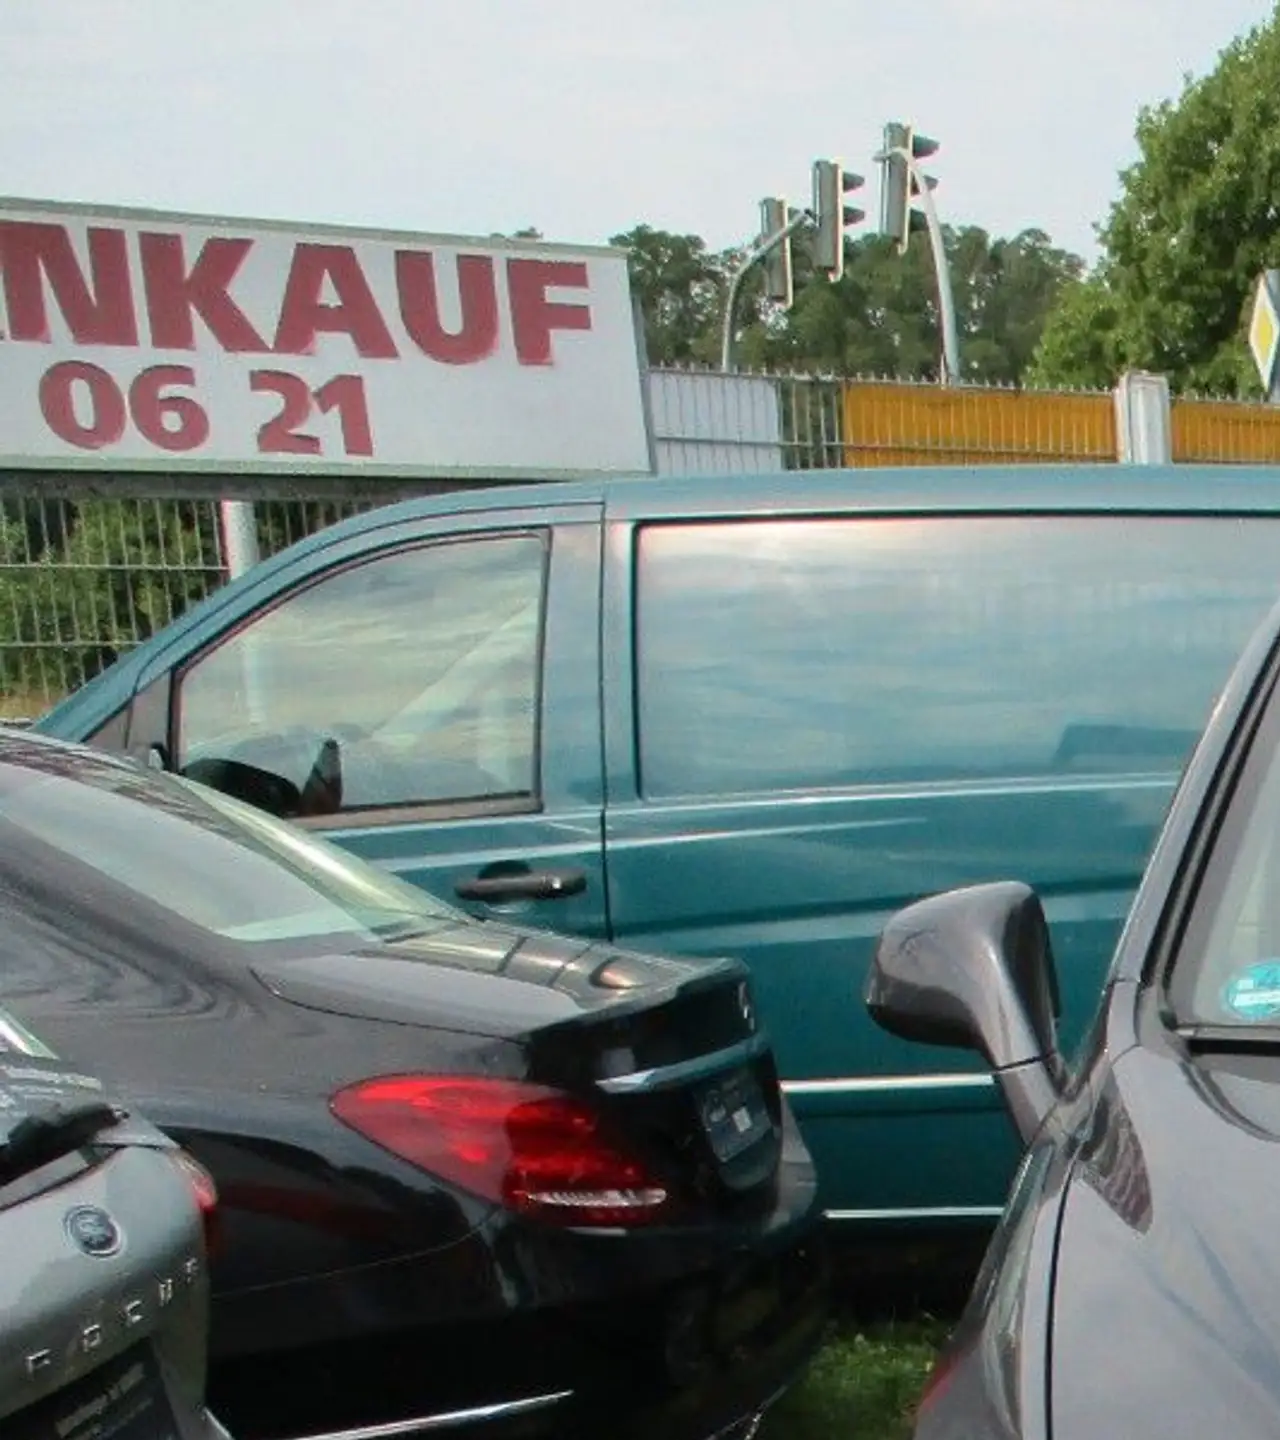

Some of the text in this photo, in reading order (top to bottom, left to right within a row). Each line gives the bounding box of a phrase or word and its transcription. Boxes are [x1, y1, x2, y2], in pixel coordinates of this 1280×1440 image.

[0, 219, 592, 367] NKAUF
[38, 359, 375, 457] 06 21
